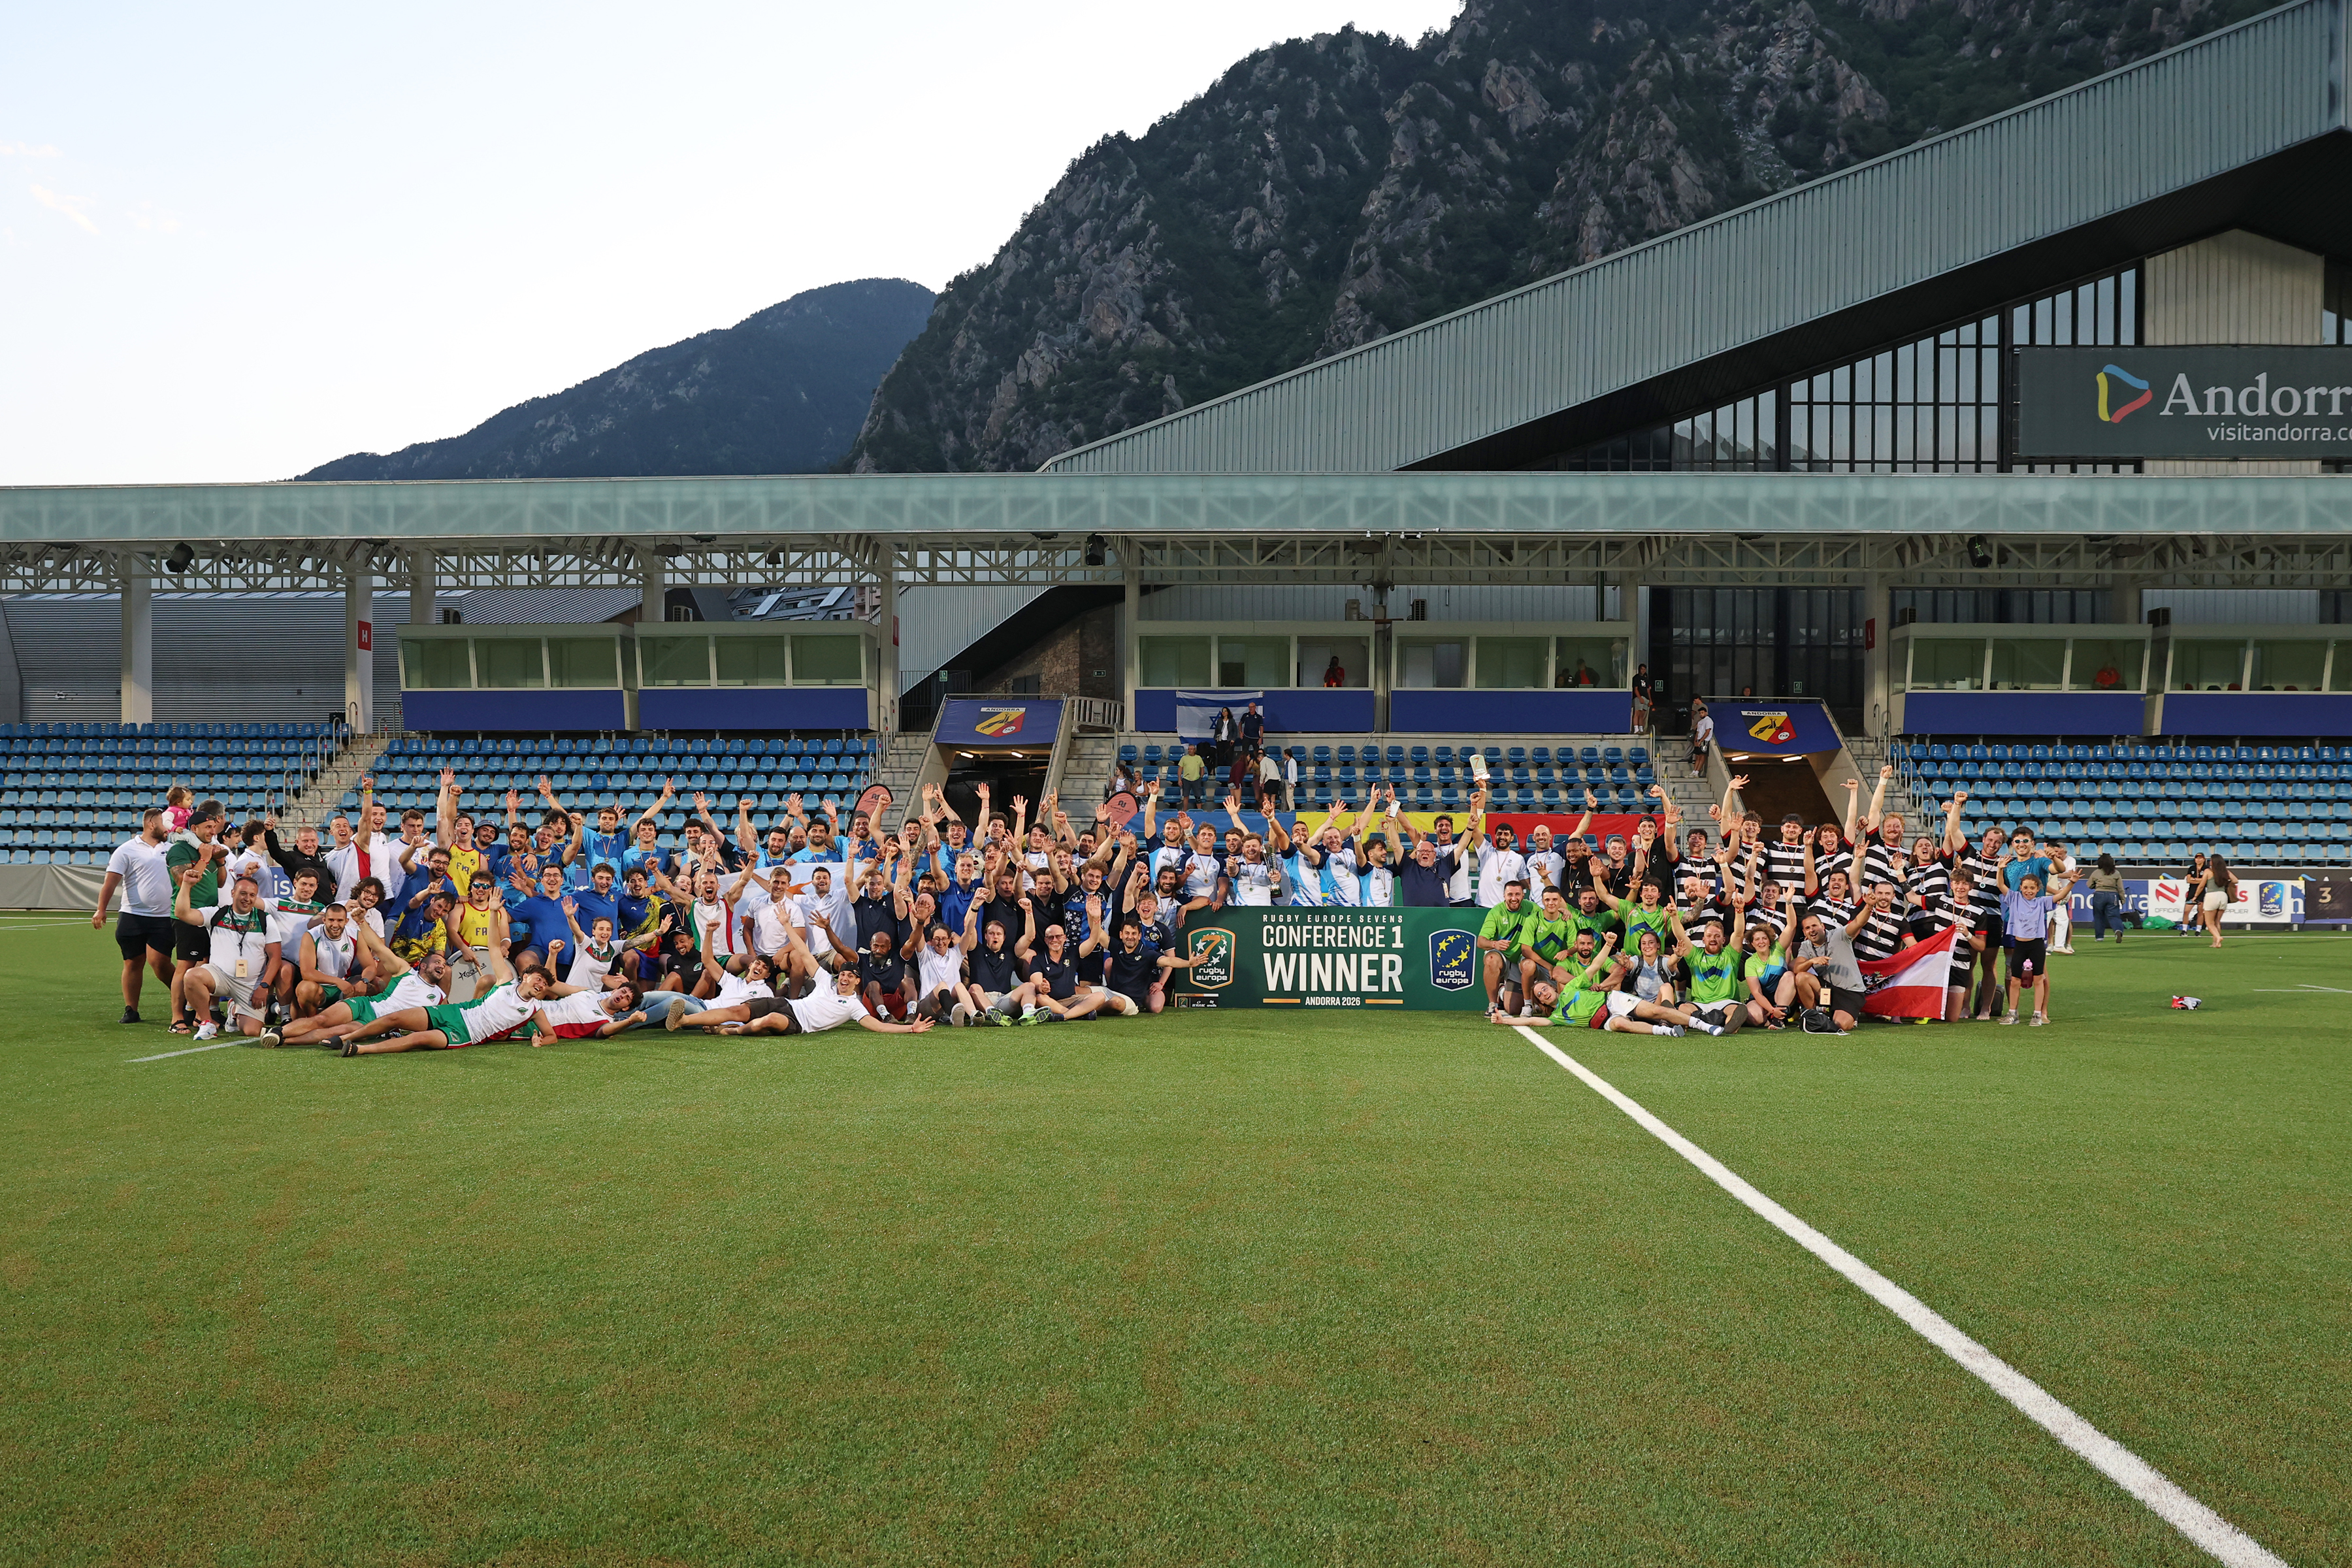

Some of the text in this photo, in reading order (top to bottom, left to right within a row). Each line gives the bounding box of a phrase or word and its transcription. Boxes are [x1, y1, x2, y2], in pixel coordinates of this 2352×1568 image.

[2159, 372, 2352, 416] Andorr
[361, 629, 368, 643] H
[2319, 887, 2332, 904] 3
[1262, 925, 1404, 948] CONFERENCE 1
[1263, 953, 1403, 992] WINNER
[1305, 996, 1361, 1005] ANDORRA 2026
